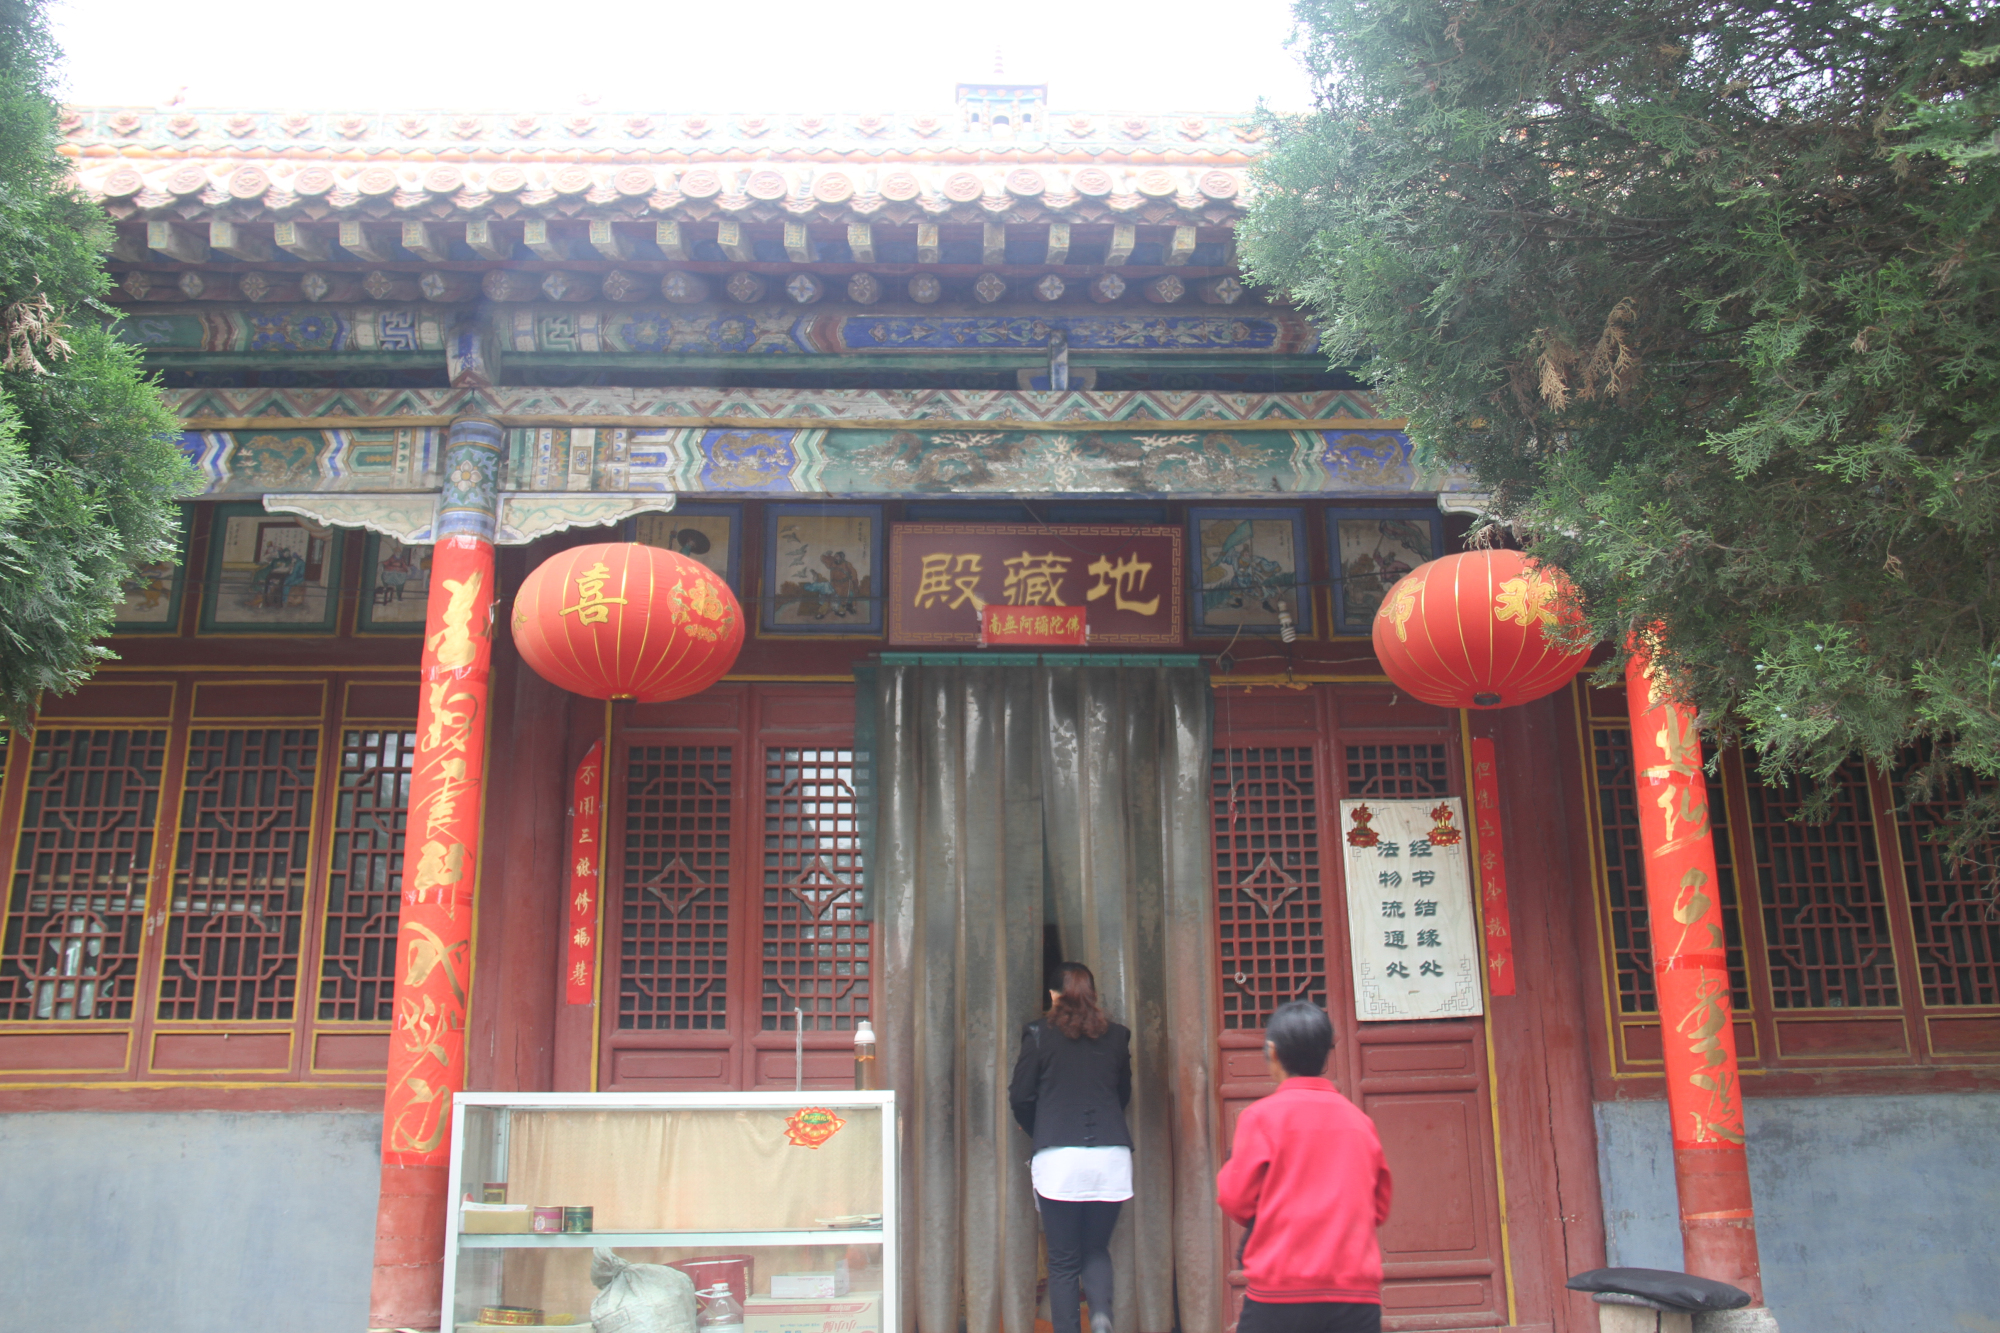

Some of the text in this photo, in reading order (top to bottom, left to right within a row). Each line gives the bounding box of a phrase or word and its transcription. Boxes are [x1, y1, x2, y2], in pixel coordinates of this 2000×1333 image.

[559, 562, 629, 626] 喜
[989, 613, 1080, 637] 南無阿彌陀佛
[1377, 841, 1410, 978] 法物流通处
[1409, 840, 1444, 977] 经书结缘处
